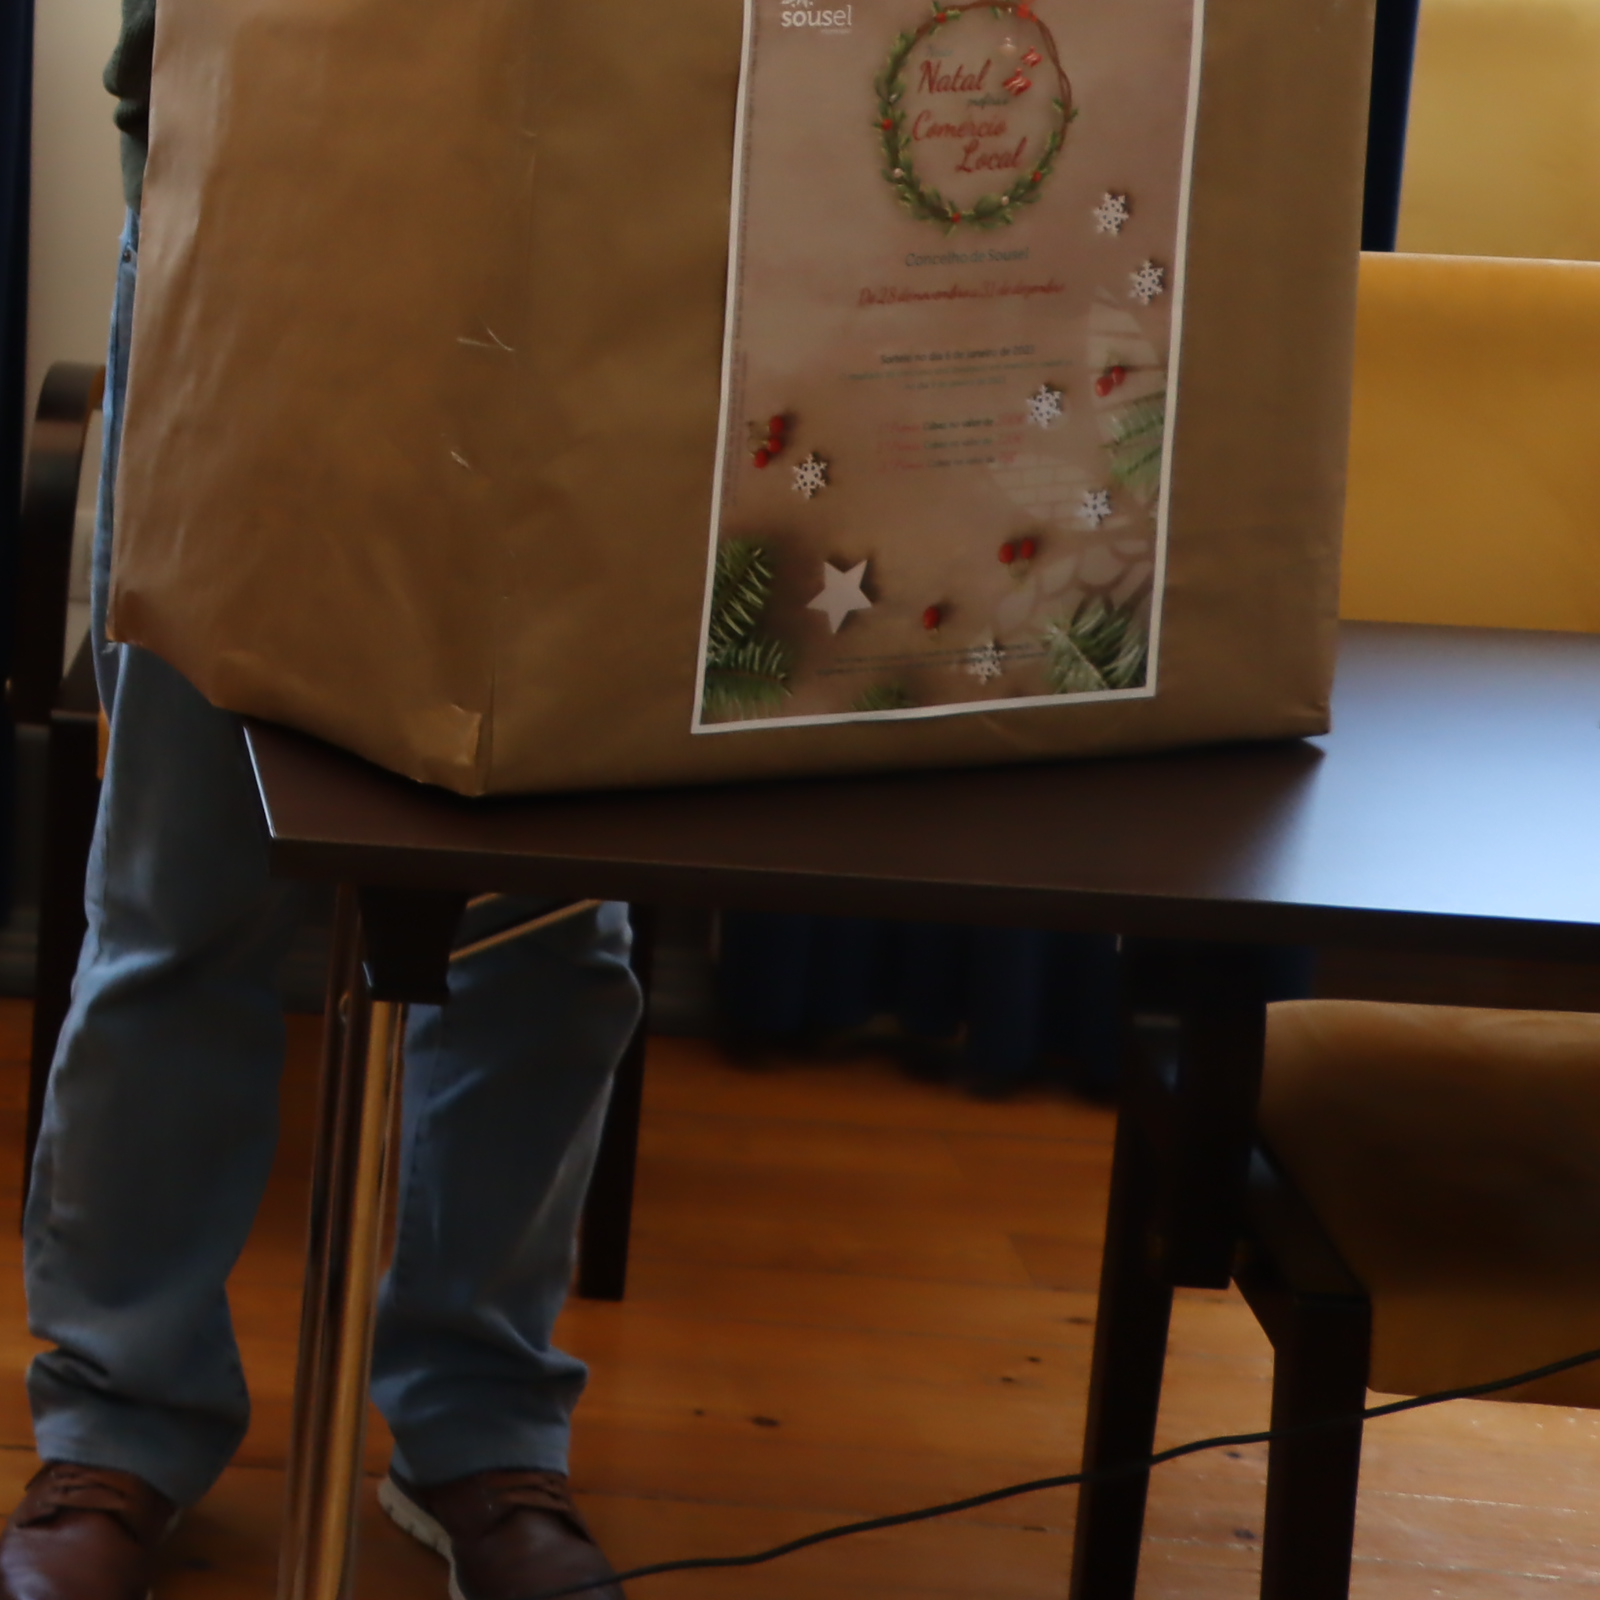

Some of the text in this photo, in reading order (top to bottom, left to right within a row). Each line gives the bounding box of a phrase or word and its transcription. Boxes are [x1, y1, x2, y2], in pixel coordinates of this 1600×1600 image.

[781, 4, 852, 27] sousel
[917, 58, 992, 94] Natal
[954, 136, 1028, 173] Local
[904, 251, 968, 267] Concelho
